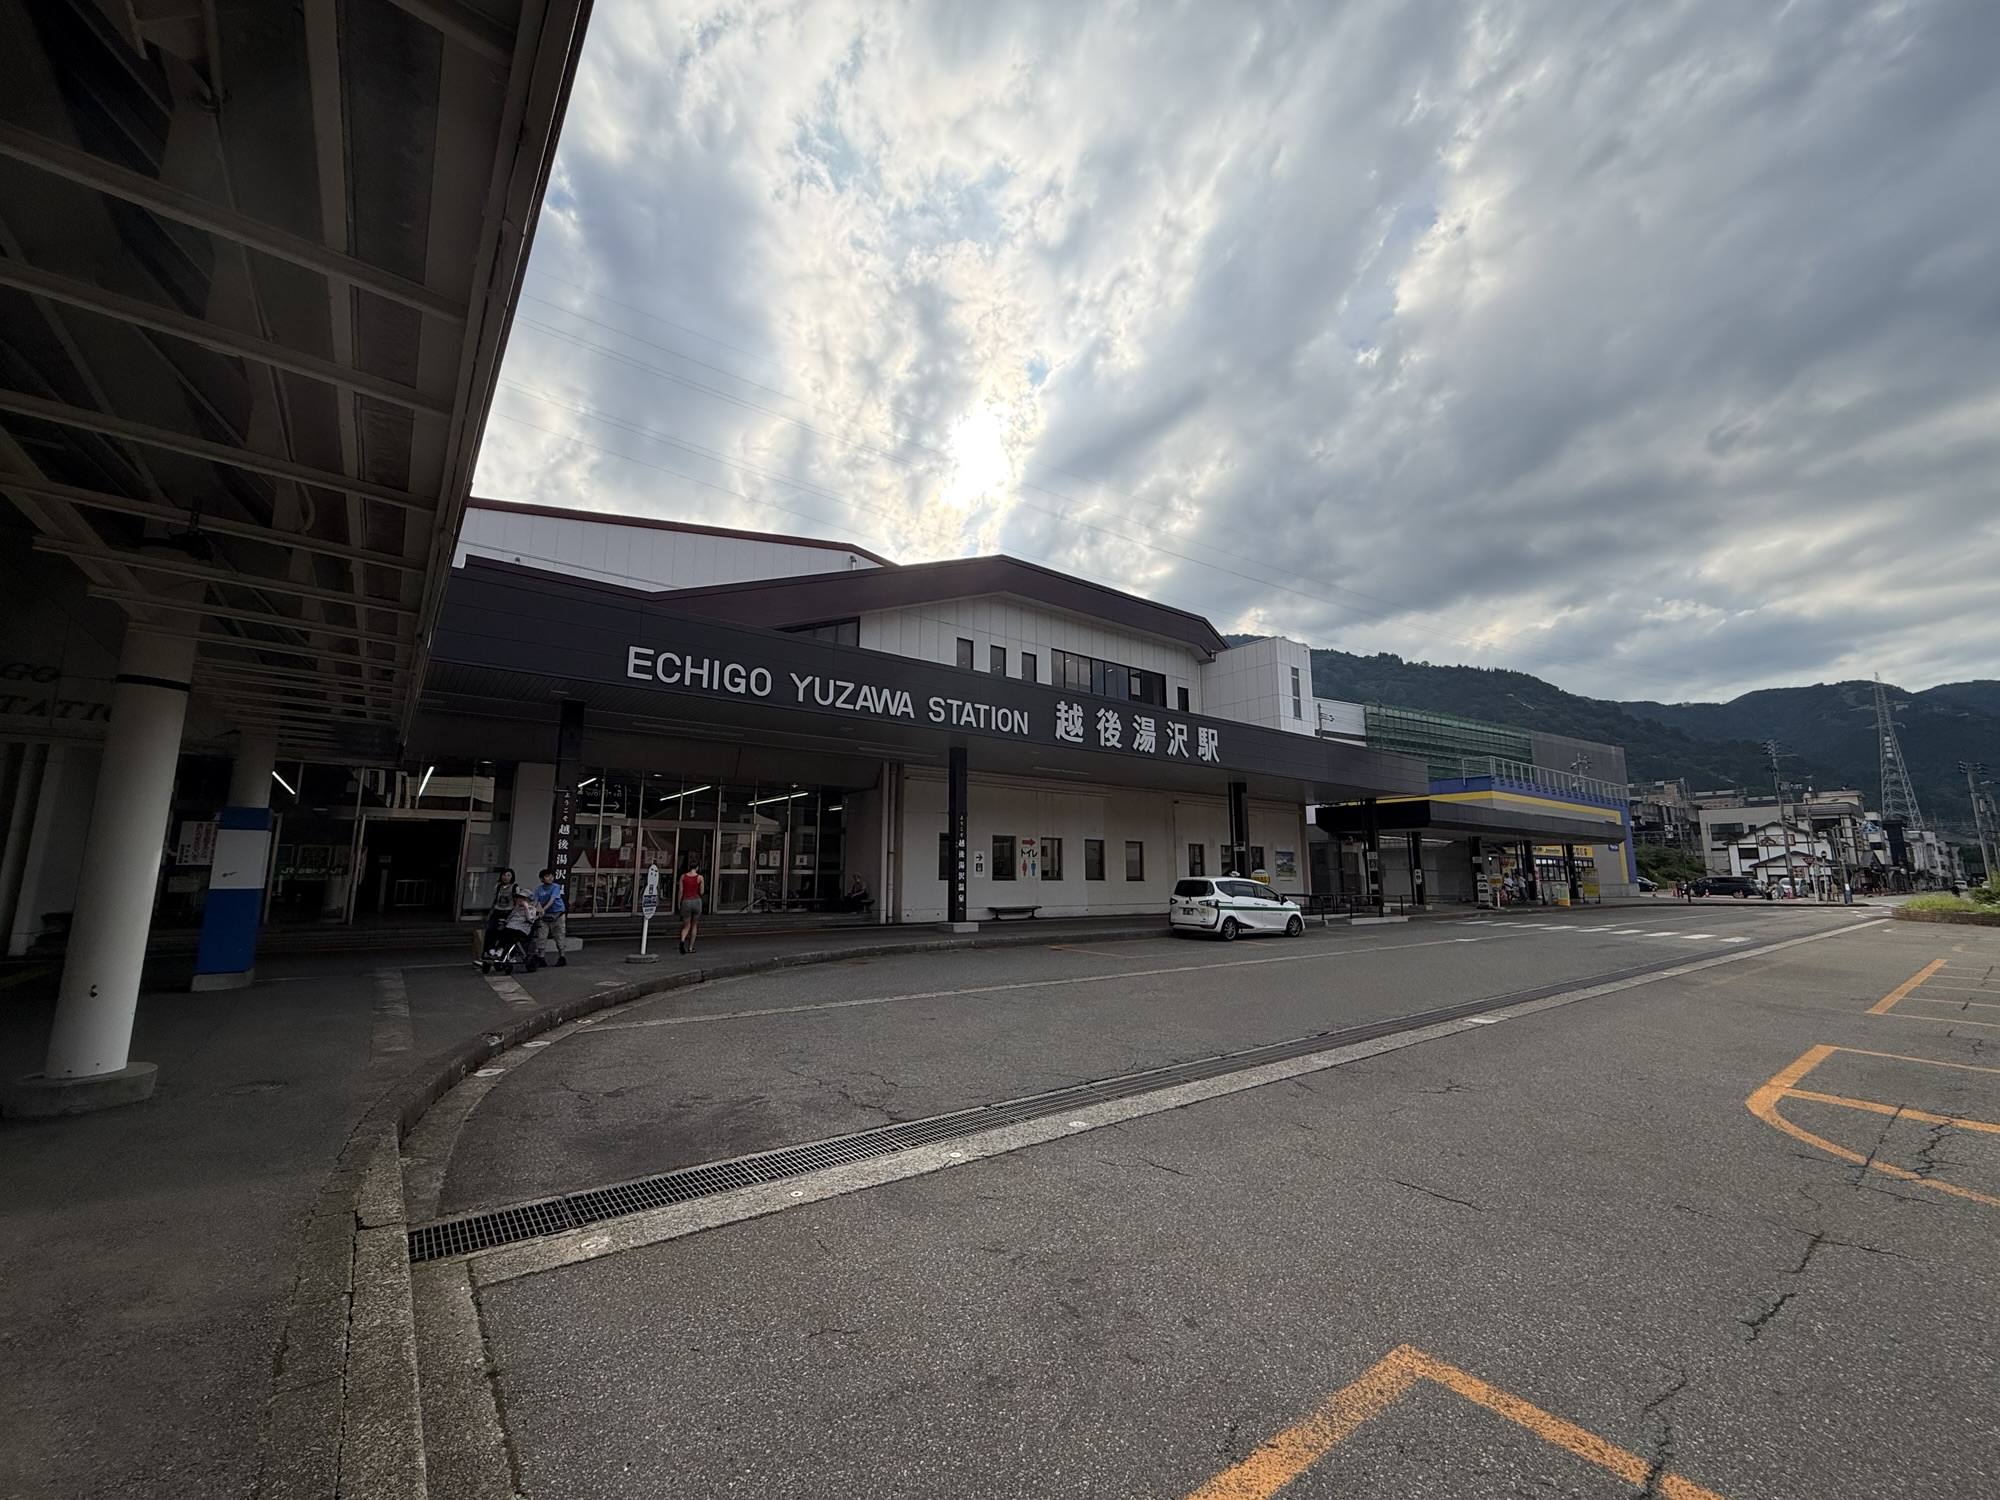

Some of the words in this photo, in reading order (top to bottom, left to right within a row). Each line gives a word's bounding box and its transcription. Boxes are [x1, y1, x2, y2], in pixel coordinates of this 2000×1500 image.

[626, 646, 773, 697] ECHIGO
[790, 672, 915, 719] YUZAWA
[928, 696, 1029, 735] STATION
[1055, 700, 1220, 763] 越後湯沢駅
[1021, 849, 1038, 858] トイレ
